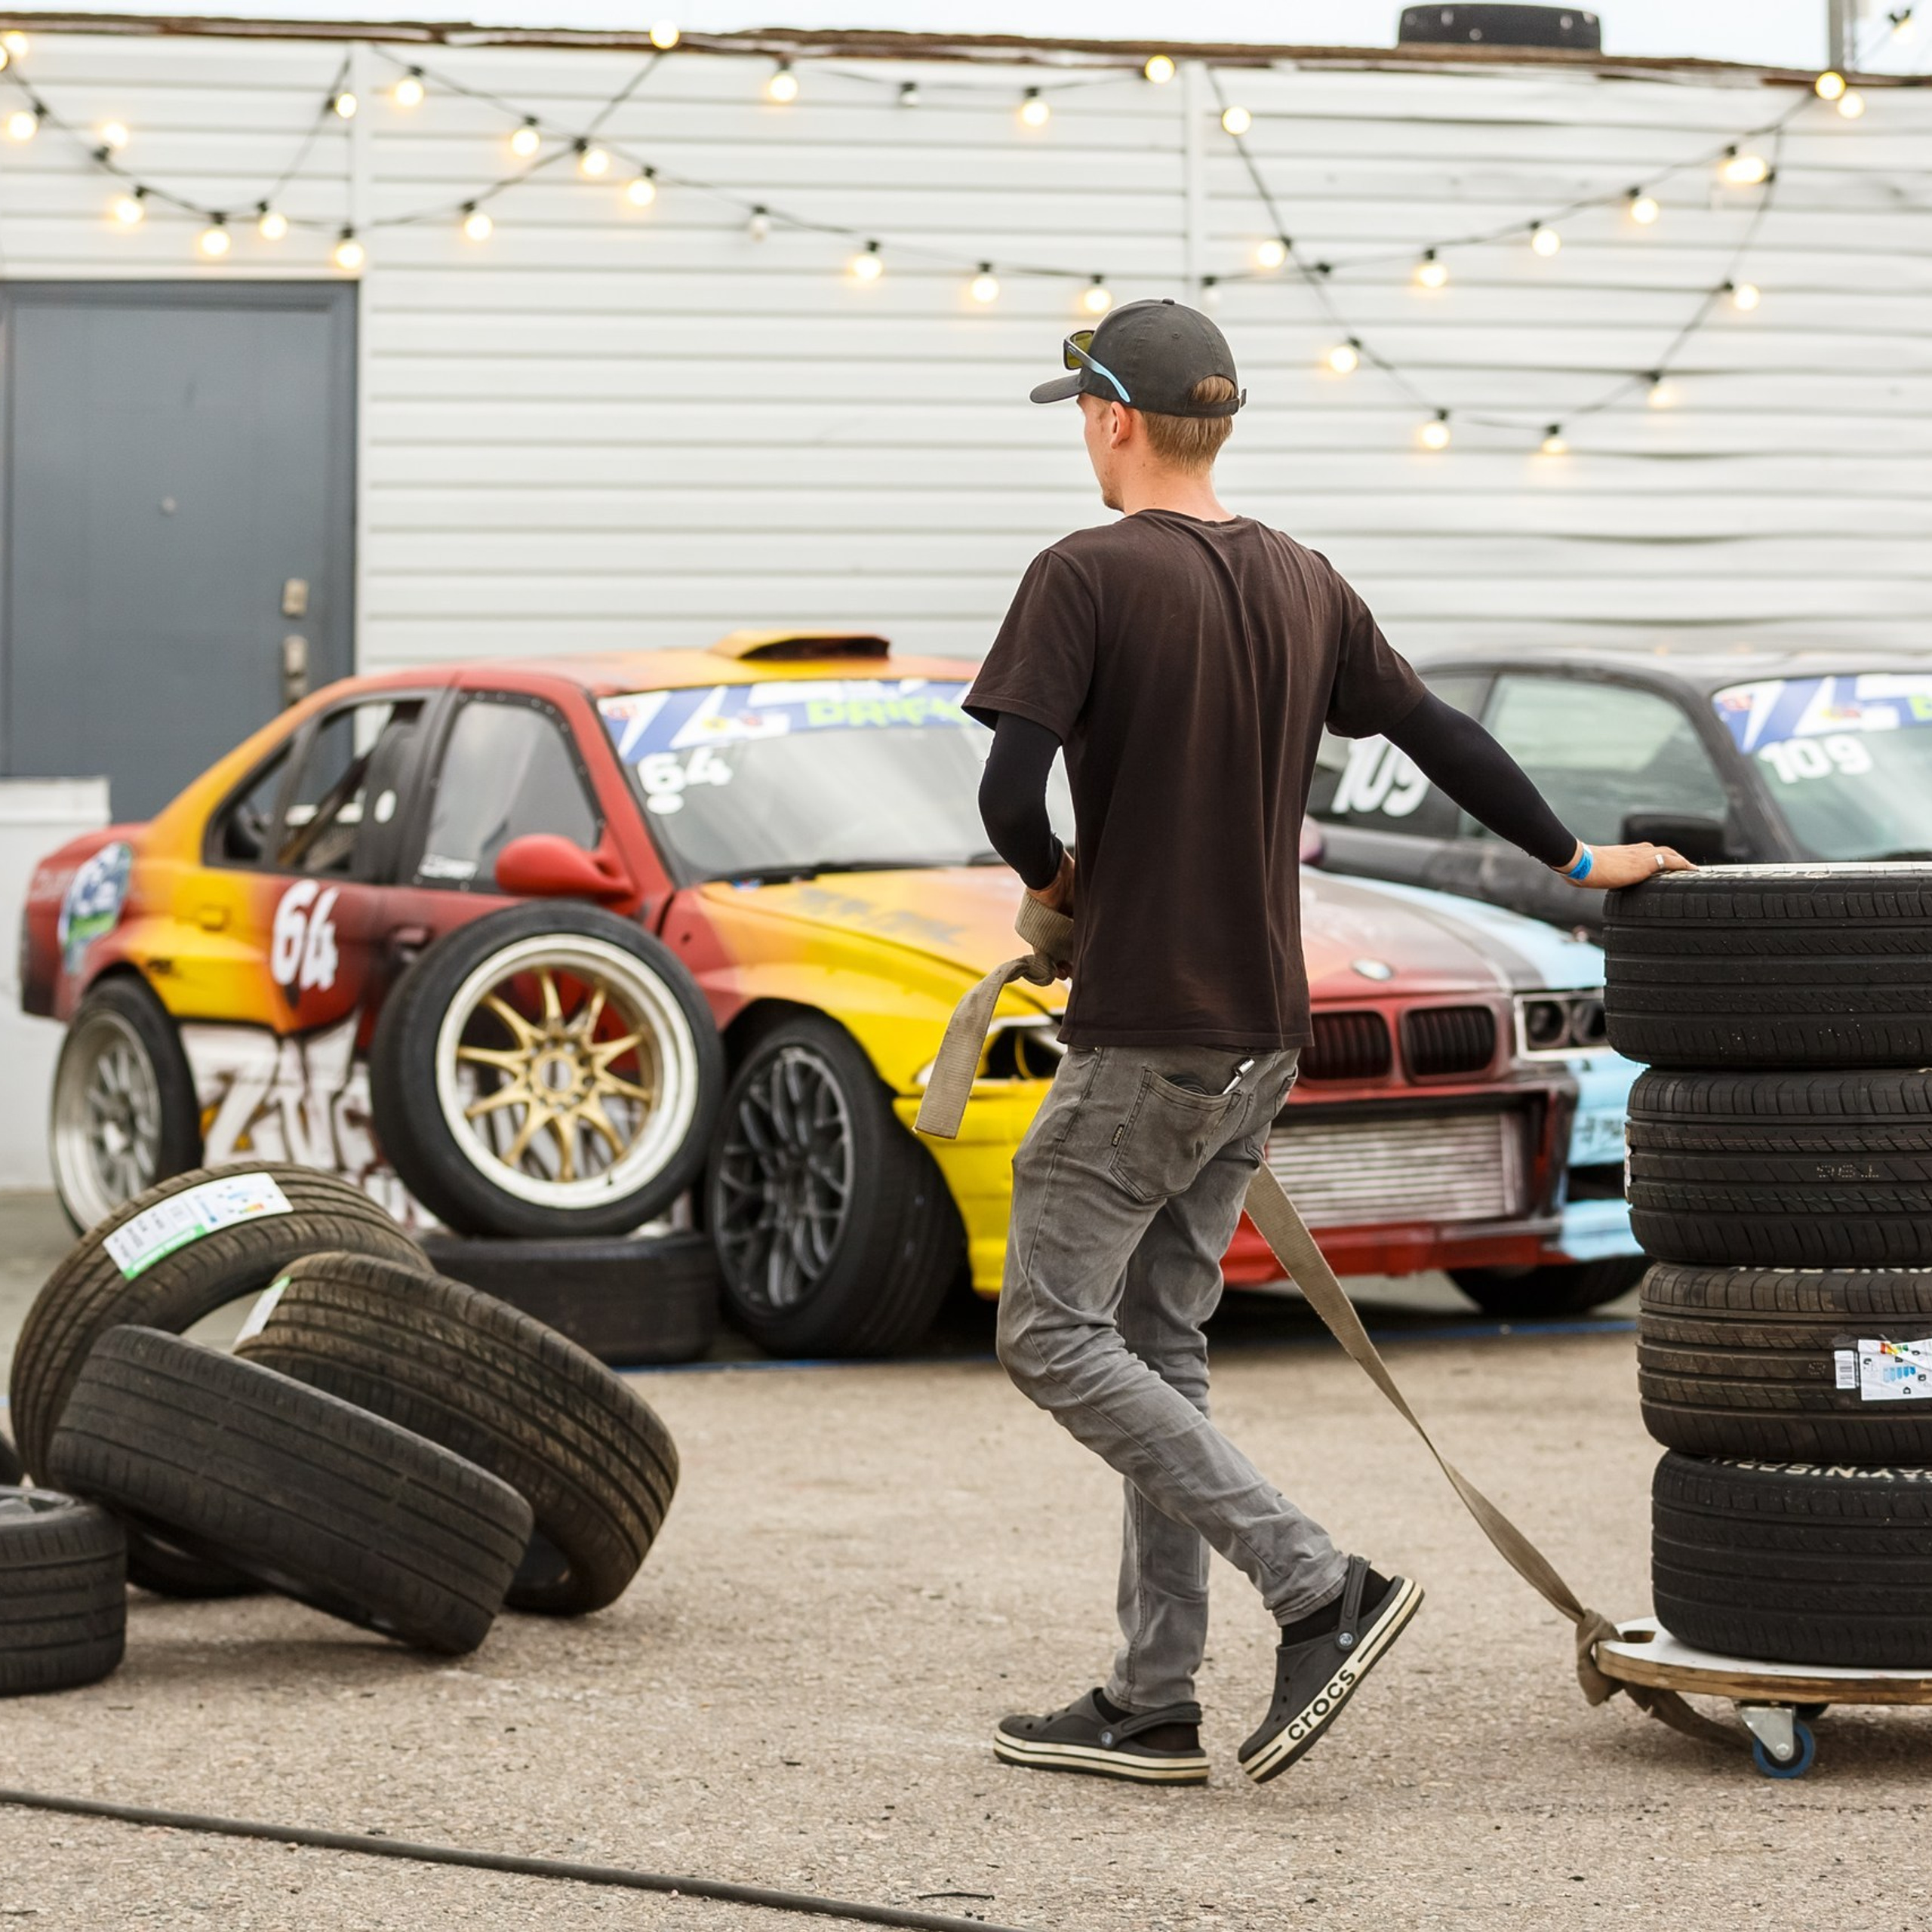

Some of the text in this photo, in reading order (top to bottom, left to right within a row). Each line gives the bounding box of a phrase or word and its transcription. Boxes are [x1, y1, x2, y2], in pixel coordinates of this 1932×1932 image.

[637, 746, 734, 793] 64
[1331, 739, 1429, 817] 109
[1758, 734, 1874, 783] 109
[270, 878, 340, 992] 64
[1287, 1669, 1356, 1740] crocs
